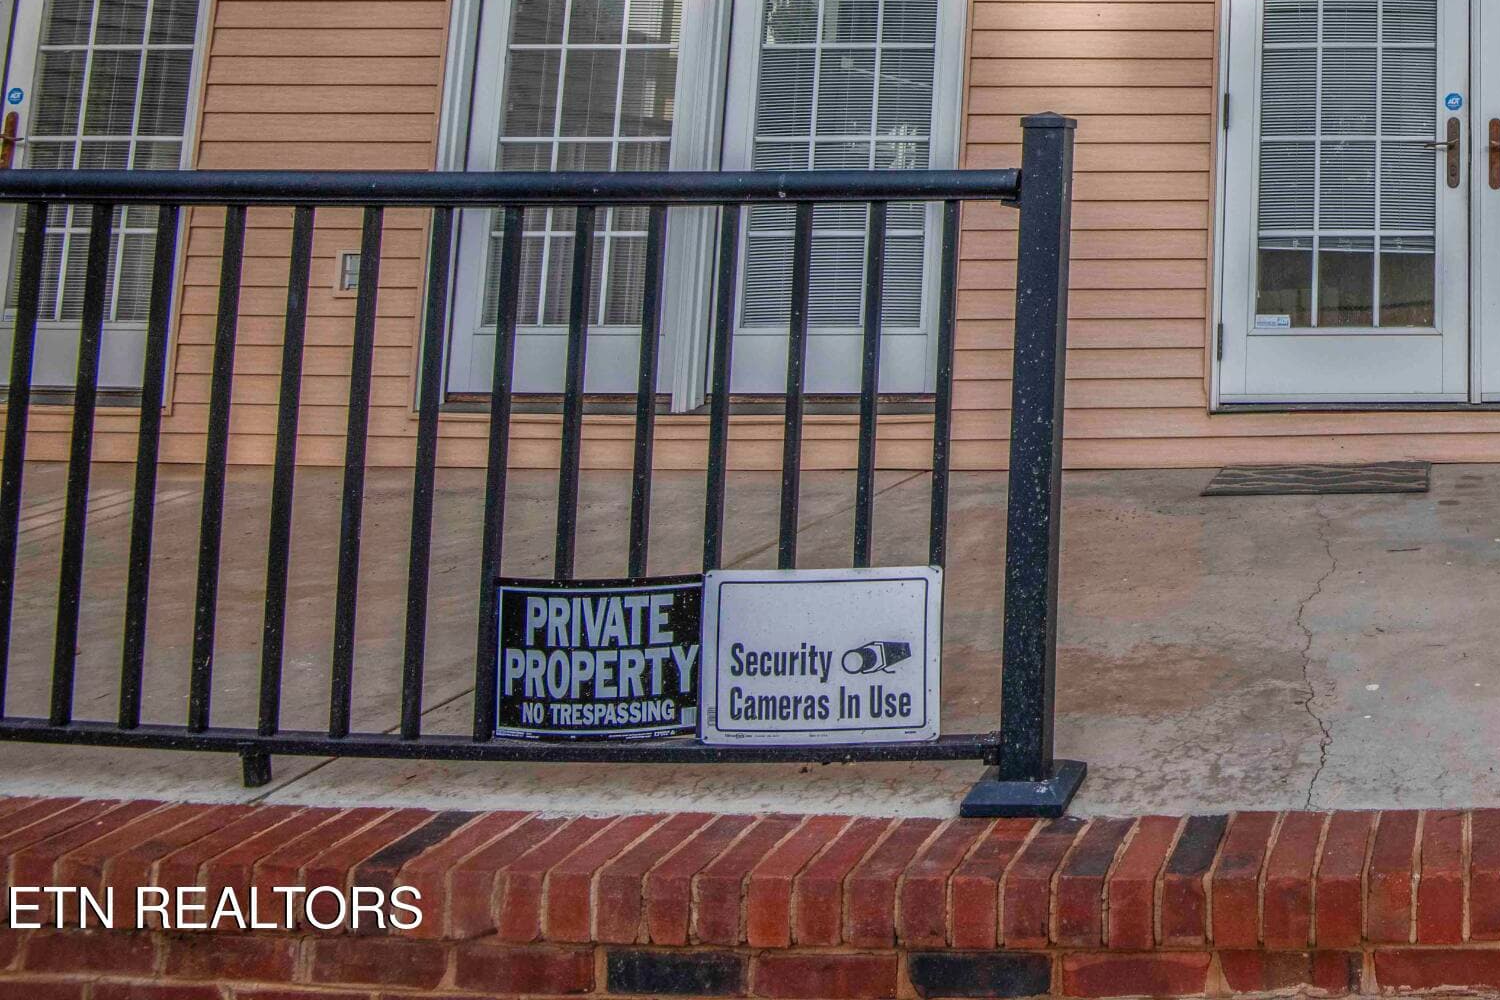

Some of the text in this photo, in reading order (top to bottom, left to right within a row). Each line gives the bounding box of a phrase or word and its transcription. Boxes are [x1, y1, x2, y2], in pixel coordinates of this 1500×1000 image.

[526, 593, 674, 647] PRIVATE
[505, 644, 700, 699] PROPERTY
[730, 642, 833, 683] Security
[522, 699, 676, 725] NO TRESPASSING
[730, 685, 911, 720] Cameras In Use
